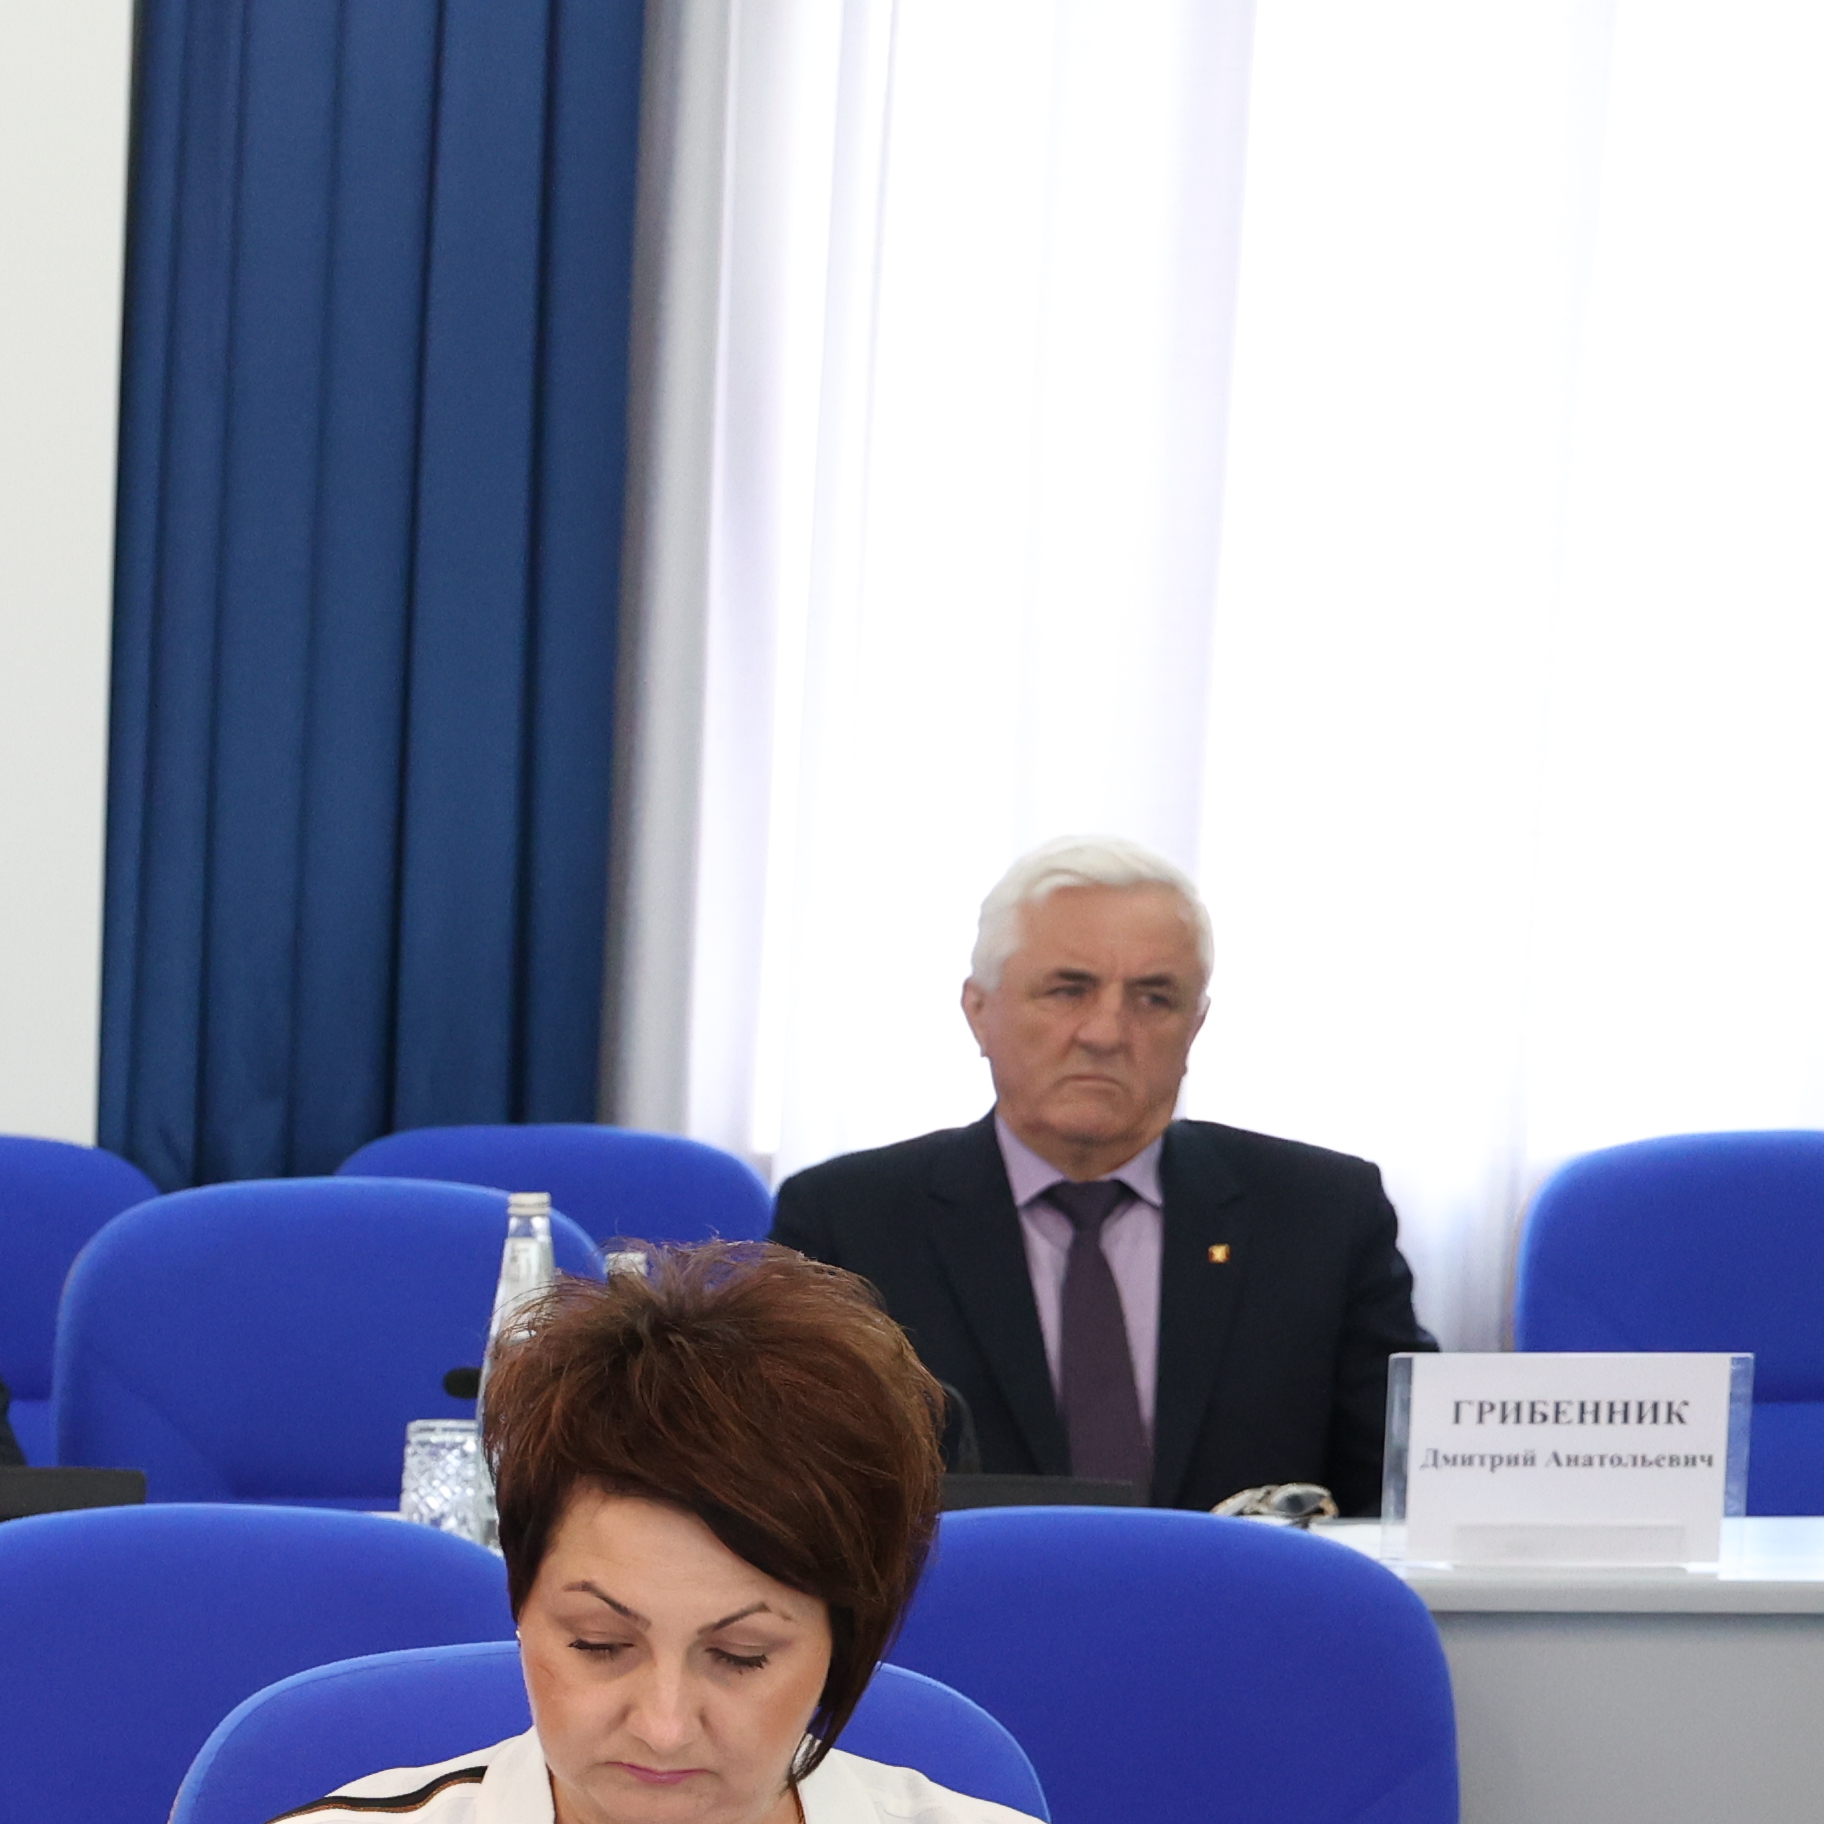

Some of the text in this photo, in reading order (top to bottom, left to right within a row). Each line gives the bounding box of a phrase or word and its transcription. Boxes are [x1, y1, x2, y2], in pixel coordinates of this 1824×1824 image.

[1452, 1399, 1689, 1426] ГРИБЕННИК
[1419, 1447, 1715, 1474] Дмитрий Анатольевич
